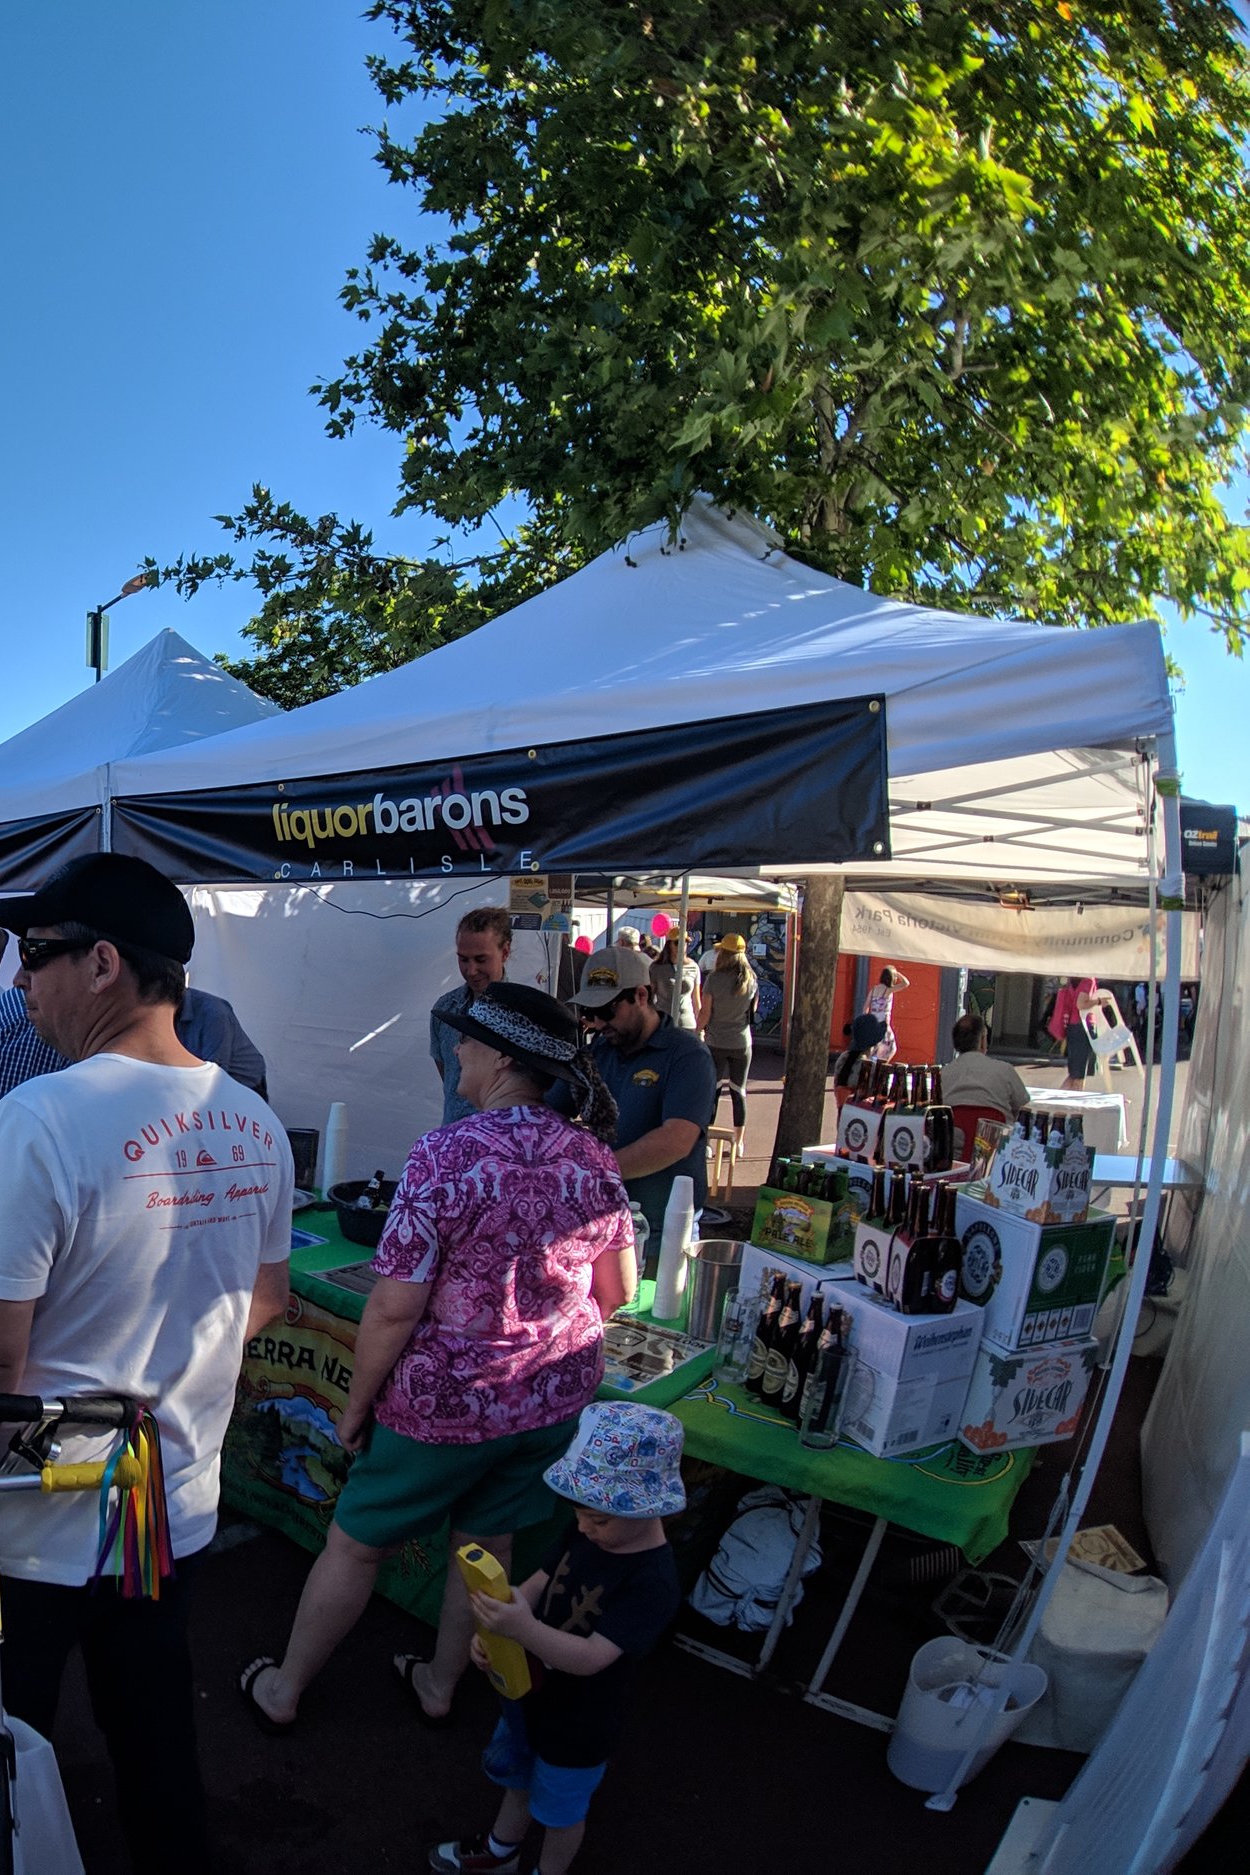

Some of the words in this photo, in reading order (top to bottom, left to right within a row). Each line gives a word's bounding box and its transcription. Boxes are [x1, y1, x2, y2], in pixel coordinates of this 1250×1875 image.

[272, 787, 530, 849] liquorbarons
[280, 851, 532, 879] CARLISLE
[124, 1110, 273, 1162] QUIKSILVER
[175, 1150, 187, 1168] 19
[232, 1144, 245, 1162] 69
[998, 1161, 1039, 1200] SIDECAR
[1054, 1169, 1089, 1196] SIDECAR
[247, 1336, 317, 1371] ERRA
[1007, 1380, 1073, 1424] SIDECAR
